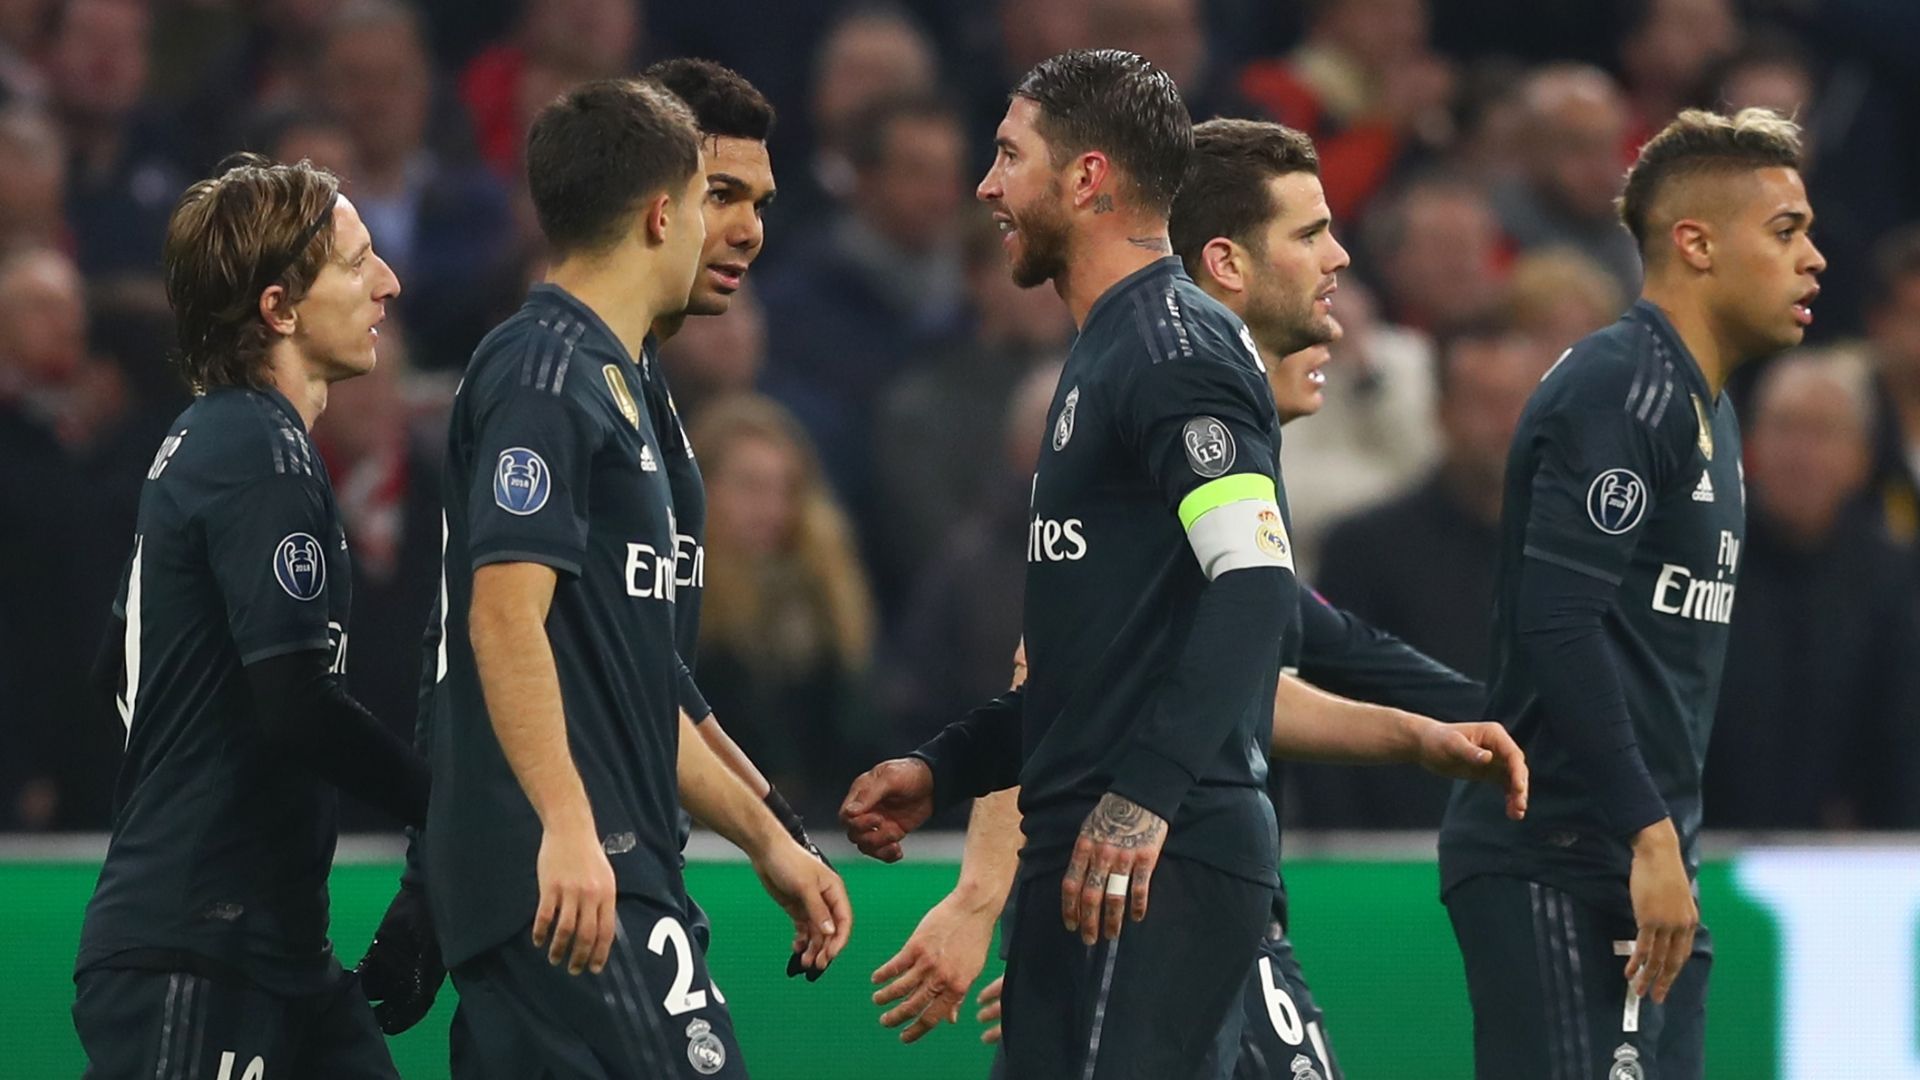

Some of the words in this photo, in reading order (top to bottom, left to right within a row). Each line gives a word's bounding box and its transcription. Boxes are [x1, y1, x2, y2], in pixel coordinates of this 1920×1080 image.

[1199, 443, 1223, 463] 13
[647, 916, 726, 1017] 2
[1258, 956, 1304, 1046] 6
